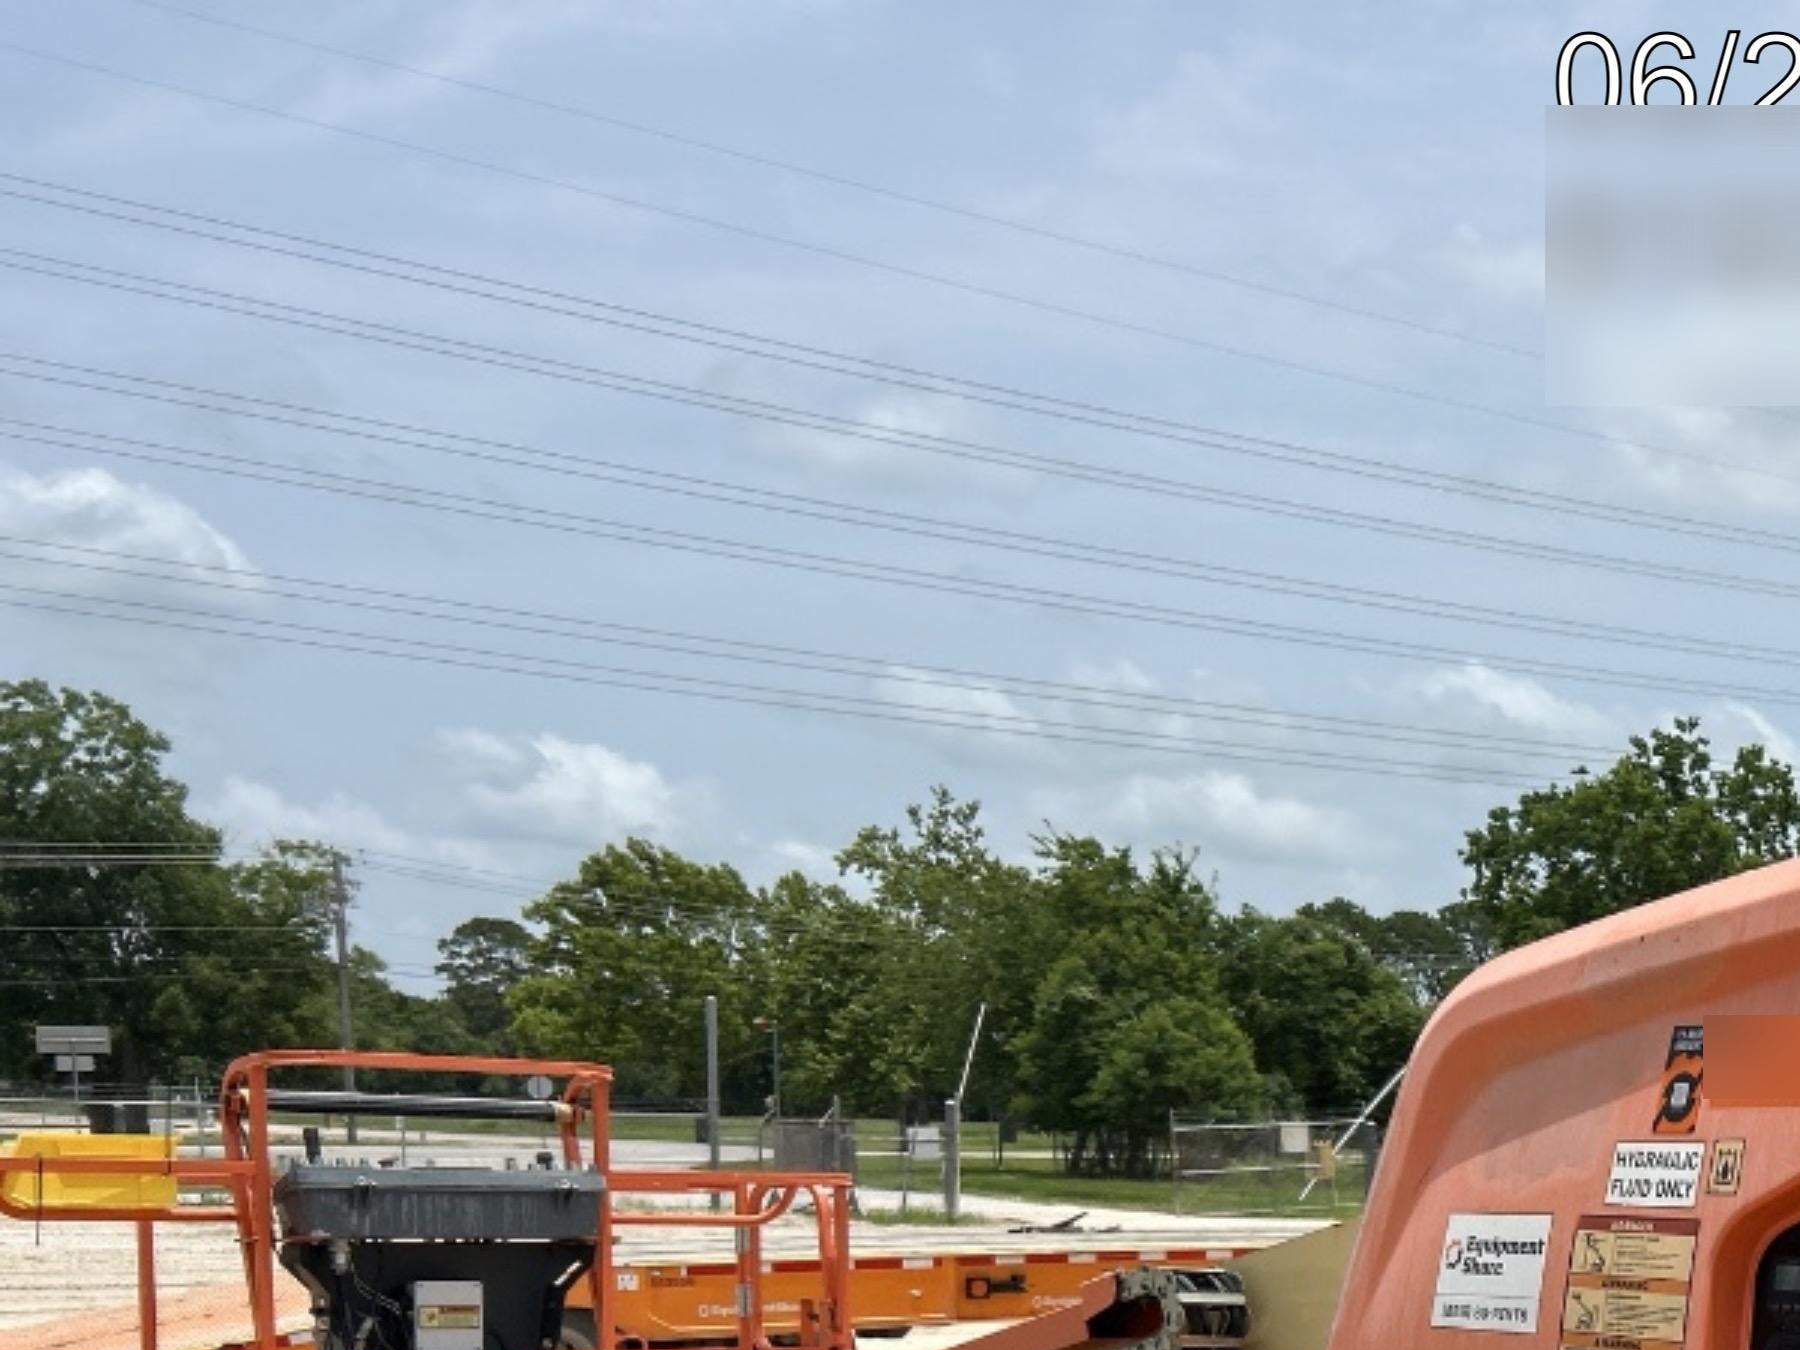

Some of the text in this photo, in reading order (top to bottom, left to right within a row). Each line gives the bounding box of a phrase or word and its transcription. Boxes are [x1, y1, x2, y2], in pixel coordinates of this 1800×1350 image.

[1615, 1150, 1699, 1171] HYDRAULIC
[1610, 1178, 1695, 1199] FLUID ONLY
[1466, 1235, 1545, 1258] Equipment
[1462, 1256, 1504, 1275] Share
